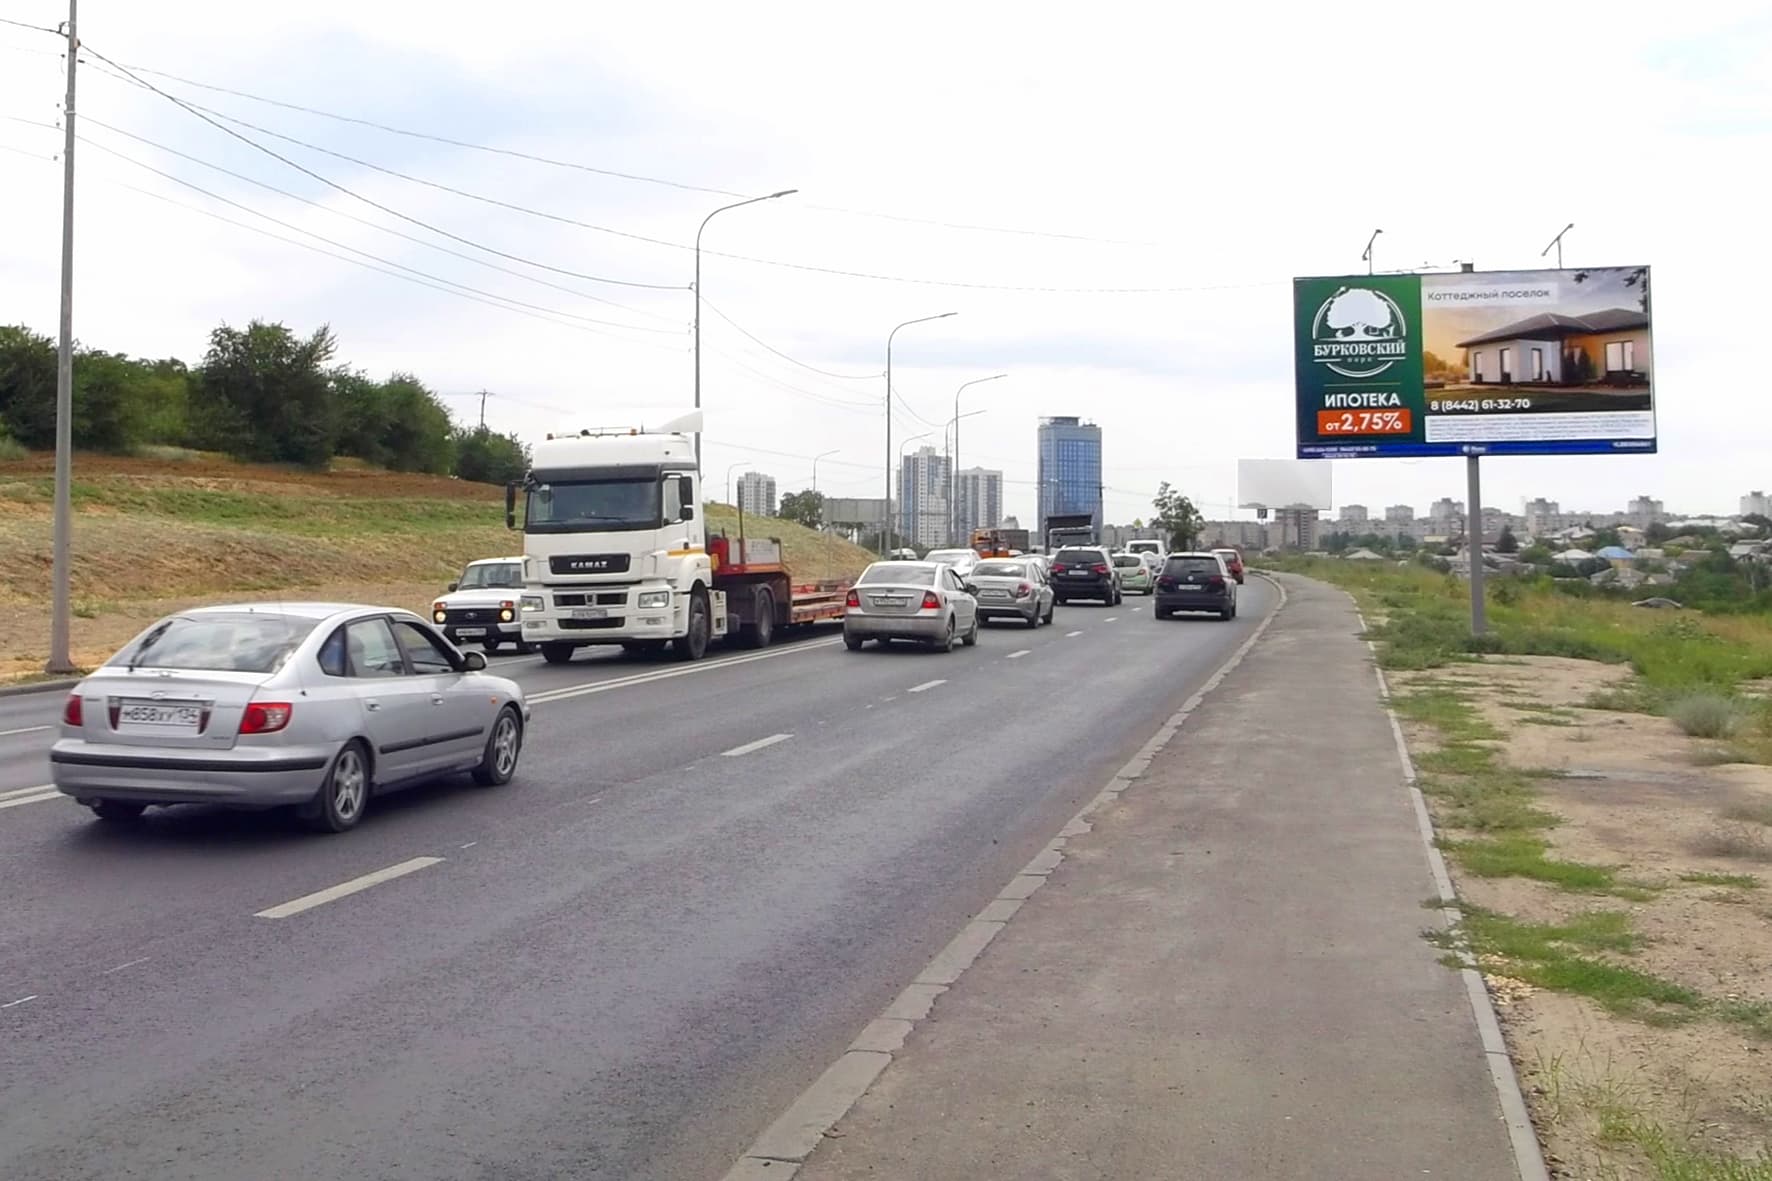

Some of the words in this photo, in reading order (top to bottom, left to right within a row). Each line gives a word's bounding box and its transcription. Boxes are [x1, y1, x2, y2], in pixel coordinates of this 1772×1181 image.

[1428, 290, 1498, 301] Коттеджный
[1501, 289, 1550, 298] поселок
[1314, 339, 1406, 357] БУРКОВСКИЙ
[1325, 393, 1401, 408] ИПОТЕКА
[1430, 400, 1439, 411] 8
[1441, 400, 1479, 412] (8442)
[1481, 398, 1531, 409] 61-32-70
[1341, 412, 1403, 432] 2,75%
